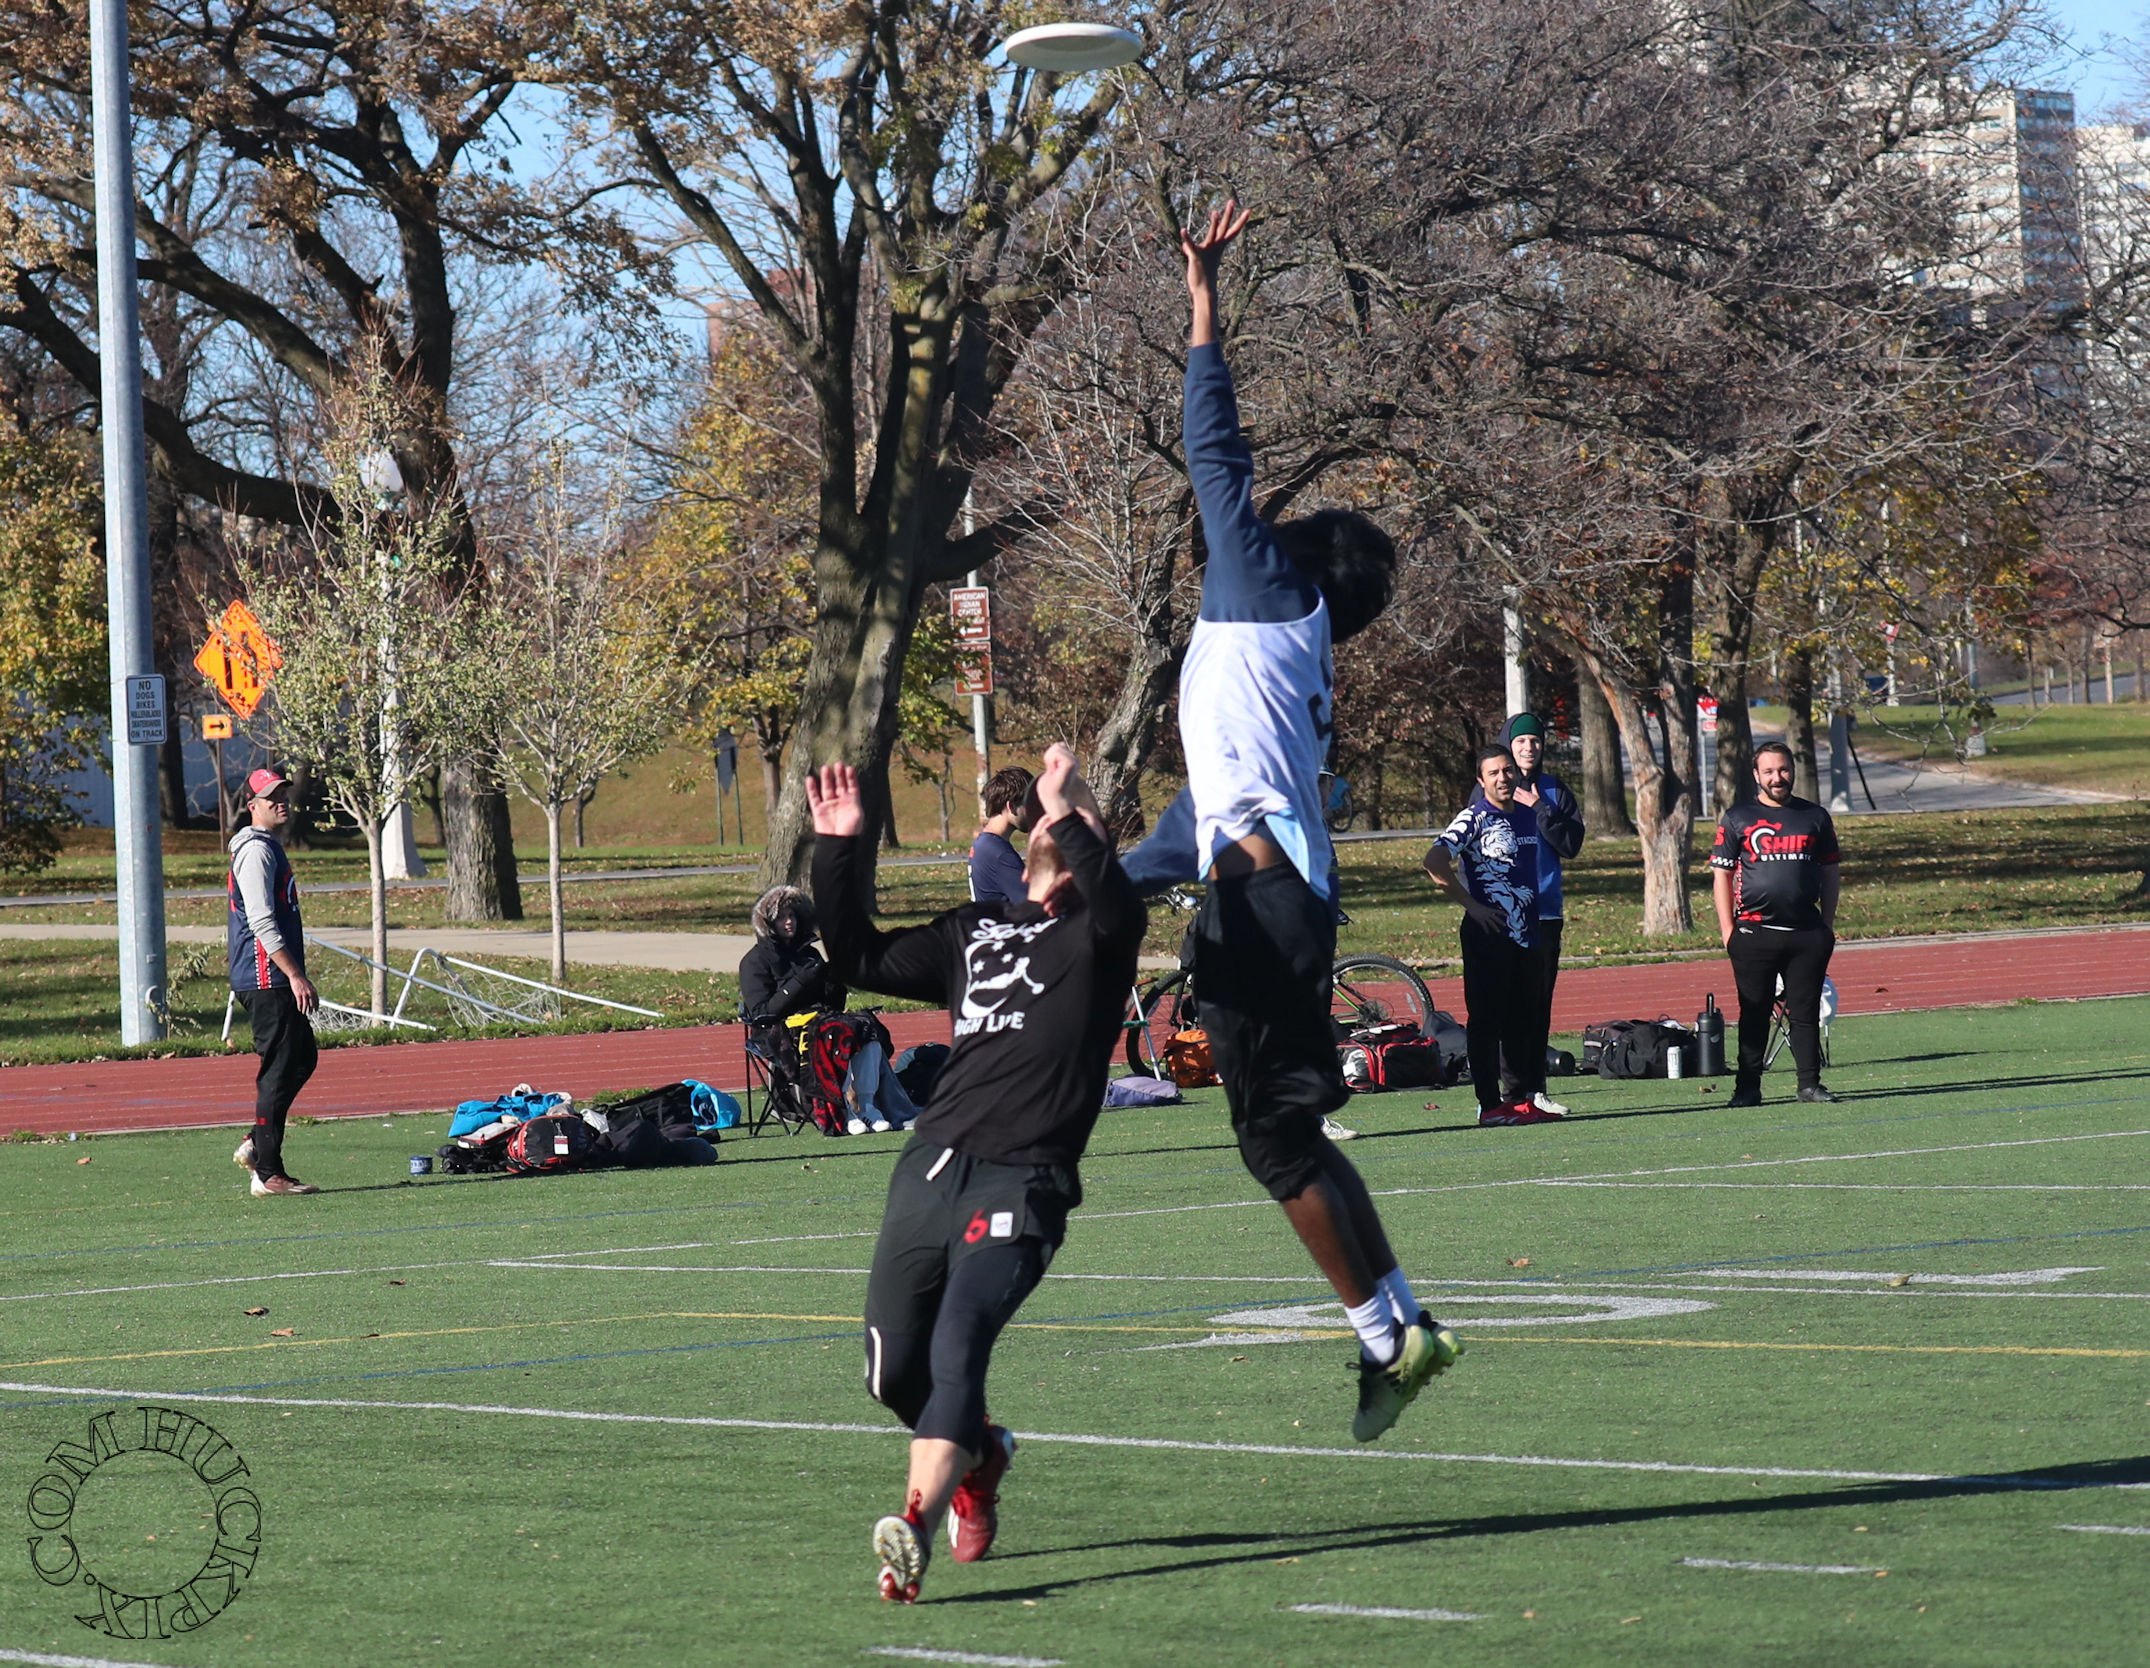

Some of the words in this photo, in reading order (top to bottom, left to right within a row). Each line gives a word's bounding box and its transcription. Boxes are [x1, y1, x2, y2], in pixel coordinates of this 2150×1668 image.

[138, 680, 151, 690] NO
[136, 701, 155, 709] BIKES
[131, 730, 140, 738] ON
[142, 729, 163, 738] TRACK
[1760, 834, 1816, 853] SHIFT
[1760, 852, 1813, 863] ULTIMATE
[954, 1017, 984, 1037] HIGH
